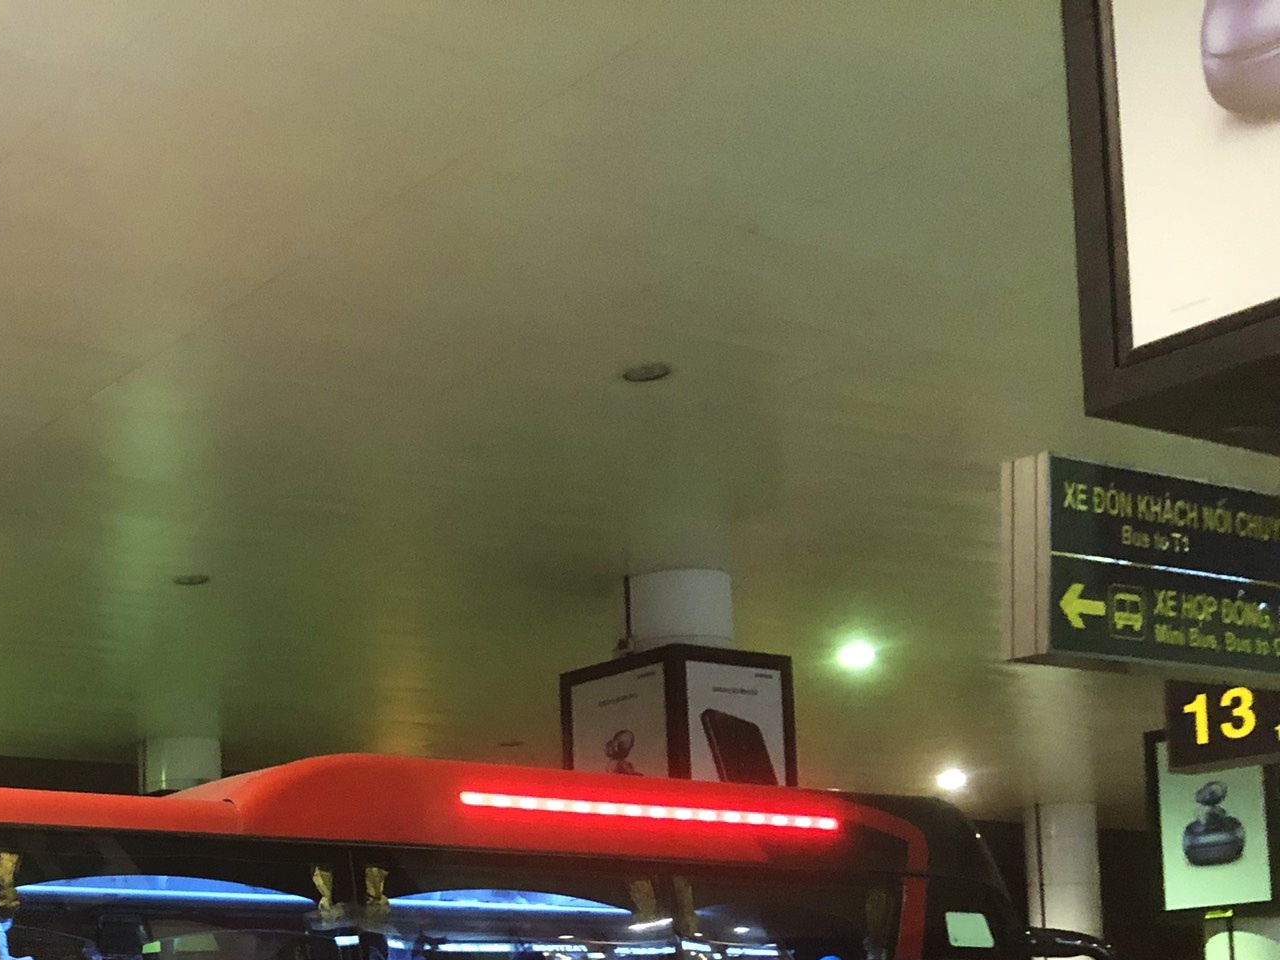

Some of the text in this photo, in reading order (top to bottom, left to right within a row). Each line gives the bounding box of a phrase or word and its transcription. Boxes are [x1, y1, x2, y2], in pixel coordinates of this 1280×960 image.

[1063, 481, 1089, 512] XE
[1092, 482, 1132, 517] ĐÓN
[1137, 492, 1199, 529] KHÁCH
[1121, 525, 1151, 548] Bus
[1153, 589, 1177, 617] XE
[1182, 686, 1258, 745] 13
